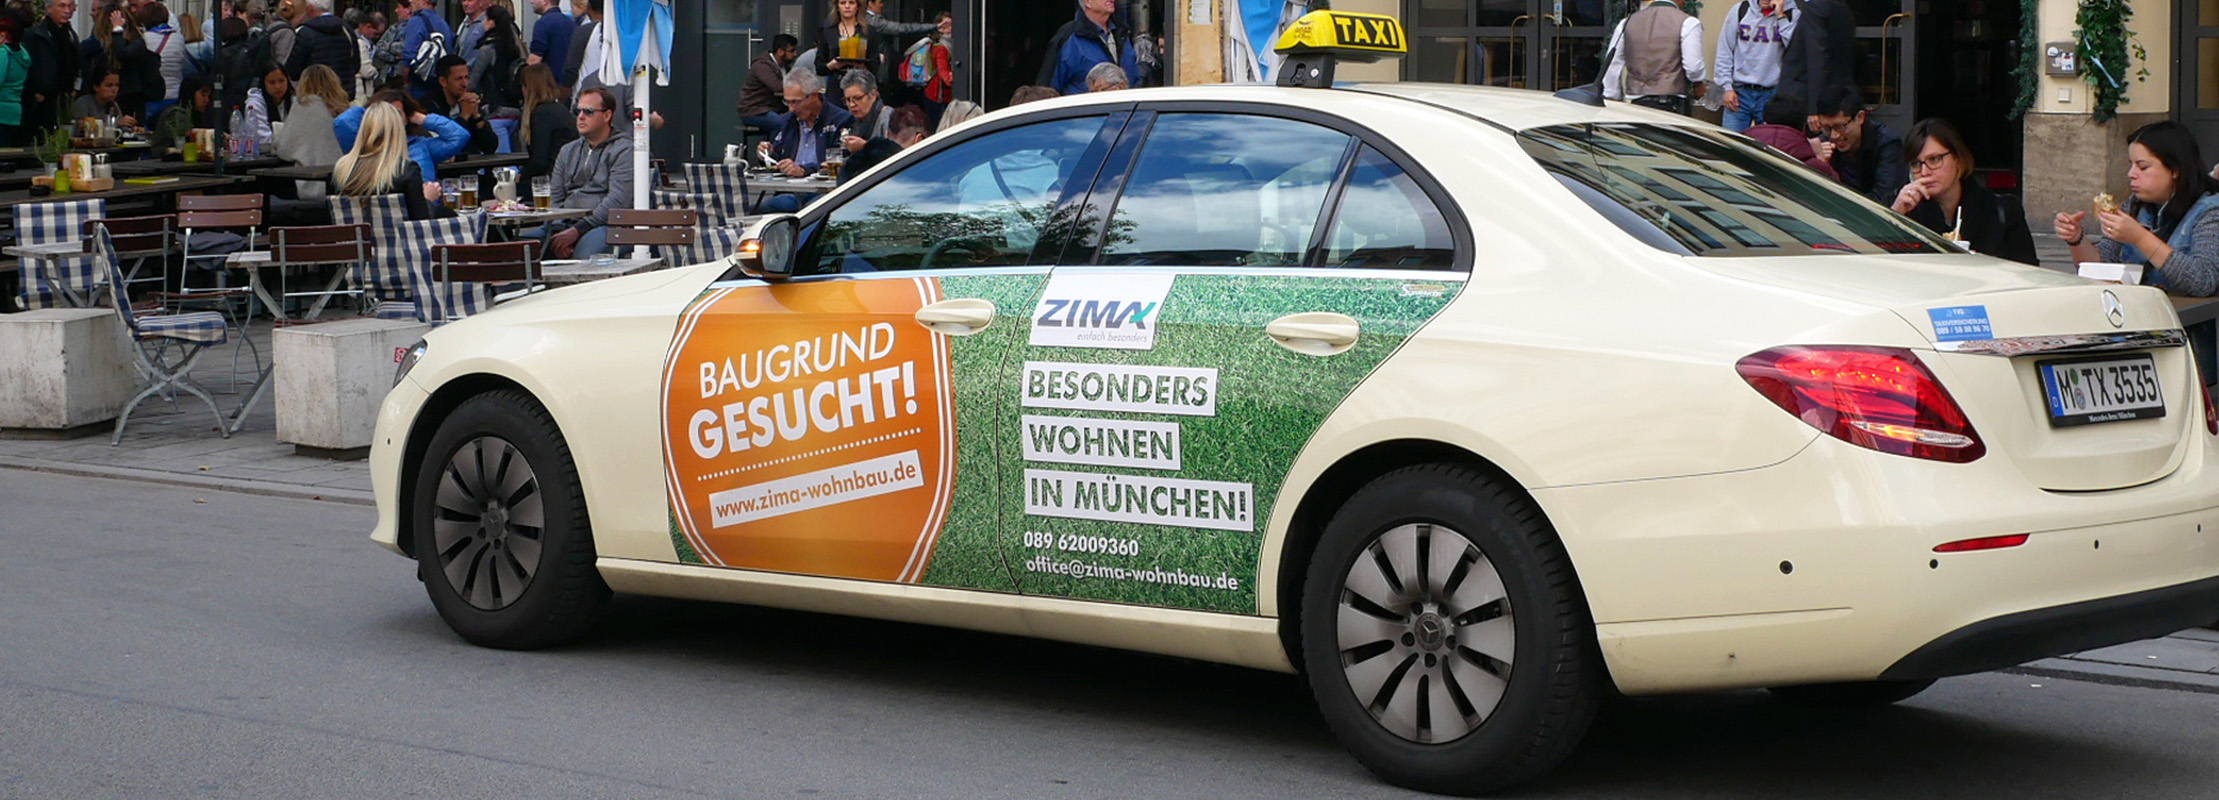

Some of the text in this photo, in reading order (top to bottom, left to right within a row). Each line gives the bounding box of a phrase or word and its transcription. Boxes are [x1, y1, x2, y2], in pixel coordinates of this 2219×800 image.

[1335, 17, 1397, 46] TAXI
[1037, 299, 1157, 330] ZIMA
[1077, 331, 1149, 343] einfach besonders
[700, 322, 895, 399] BAUGRUND
[1028, 369, 1209, 407] BESONDERS
[2056, 364, 2157, 409] M TX 3535
[688, 361, 918, 459] GESUCHT!
[1029, 424, 1174, 461] WOHNEN
[715, 460, 917, 518] www.zima-wohnbau.de
[1031, 475, 1247, 522] IN MÜNCHEN!
[1023, 531, 1140, 557] 089 62009360
[1026, 555, 1240, 591] office@zima-wohnbau.de
